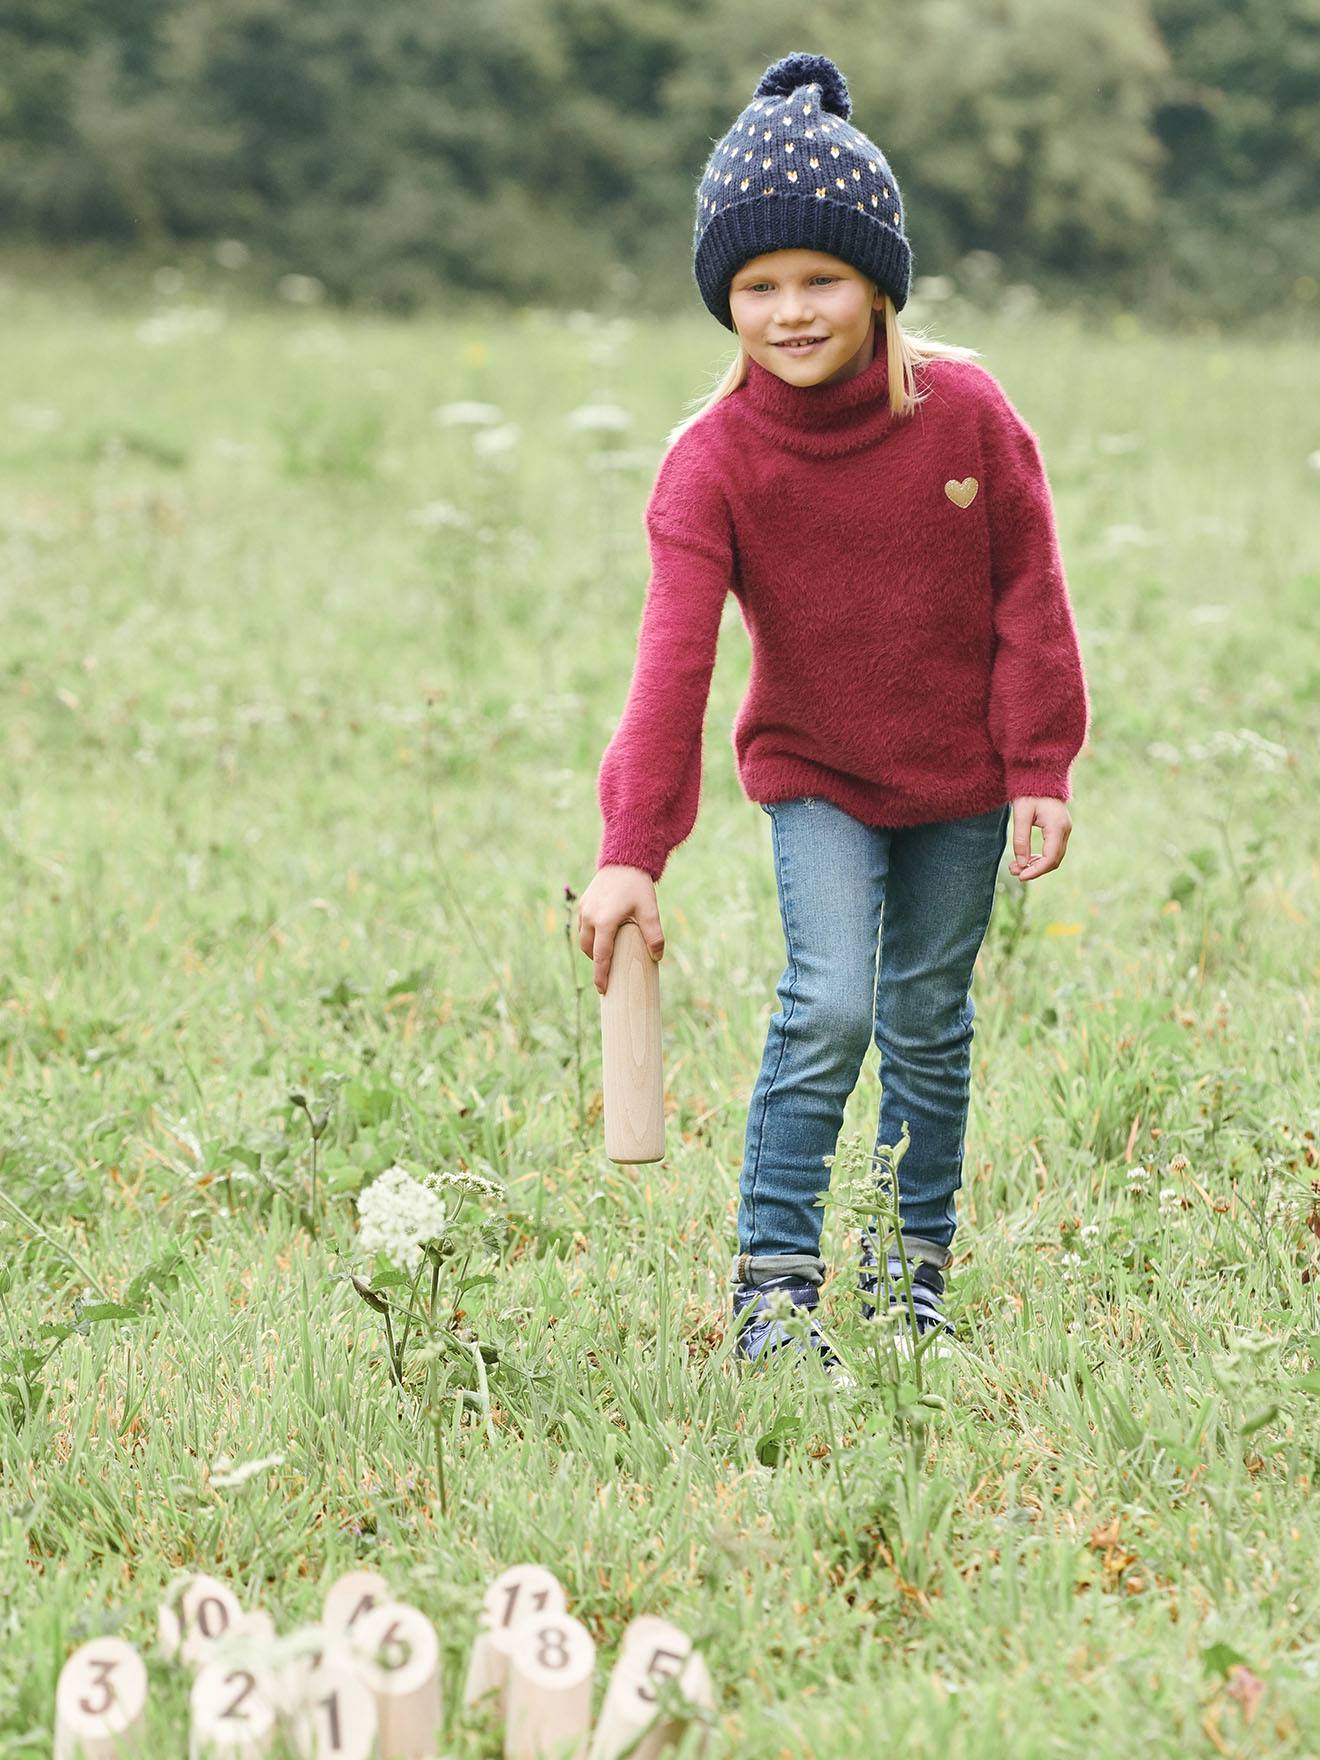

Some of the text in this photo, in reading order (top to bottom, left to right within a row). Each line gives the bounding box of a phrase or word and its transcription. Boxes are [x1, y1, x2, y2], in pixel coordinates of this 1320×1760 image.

[376, 1621, 412, 1671] 6
[537, 1627, 569, 1670] 8
[79, 1660, 118, 1715] 3
[218, 1669, 256, 1719] 2
[637, 1649, 685, 1703] 5
[320, 1689, 342, 1750] 1
